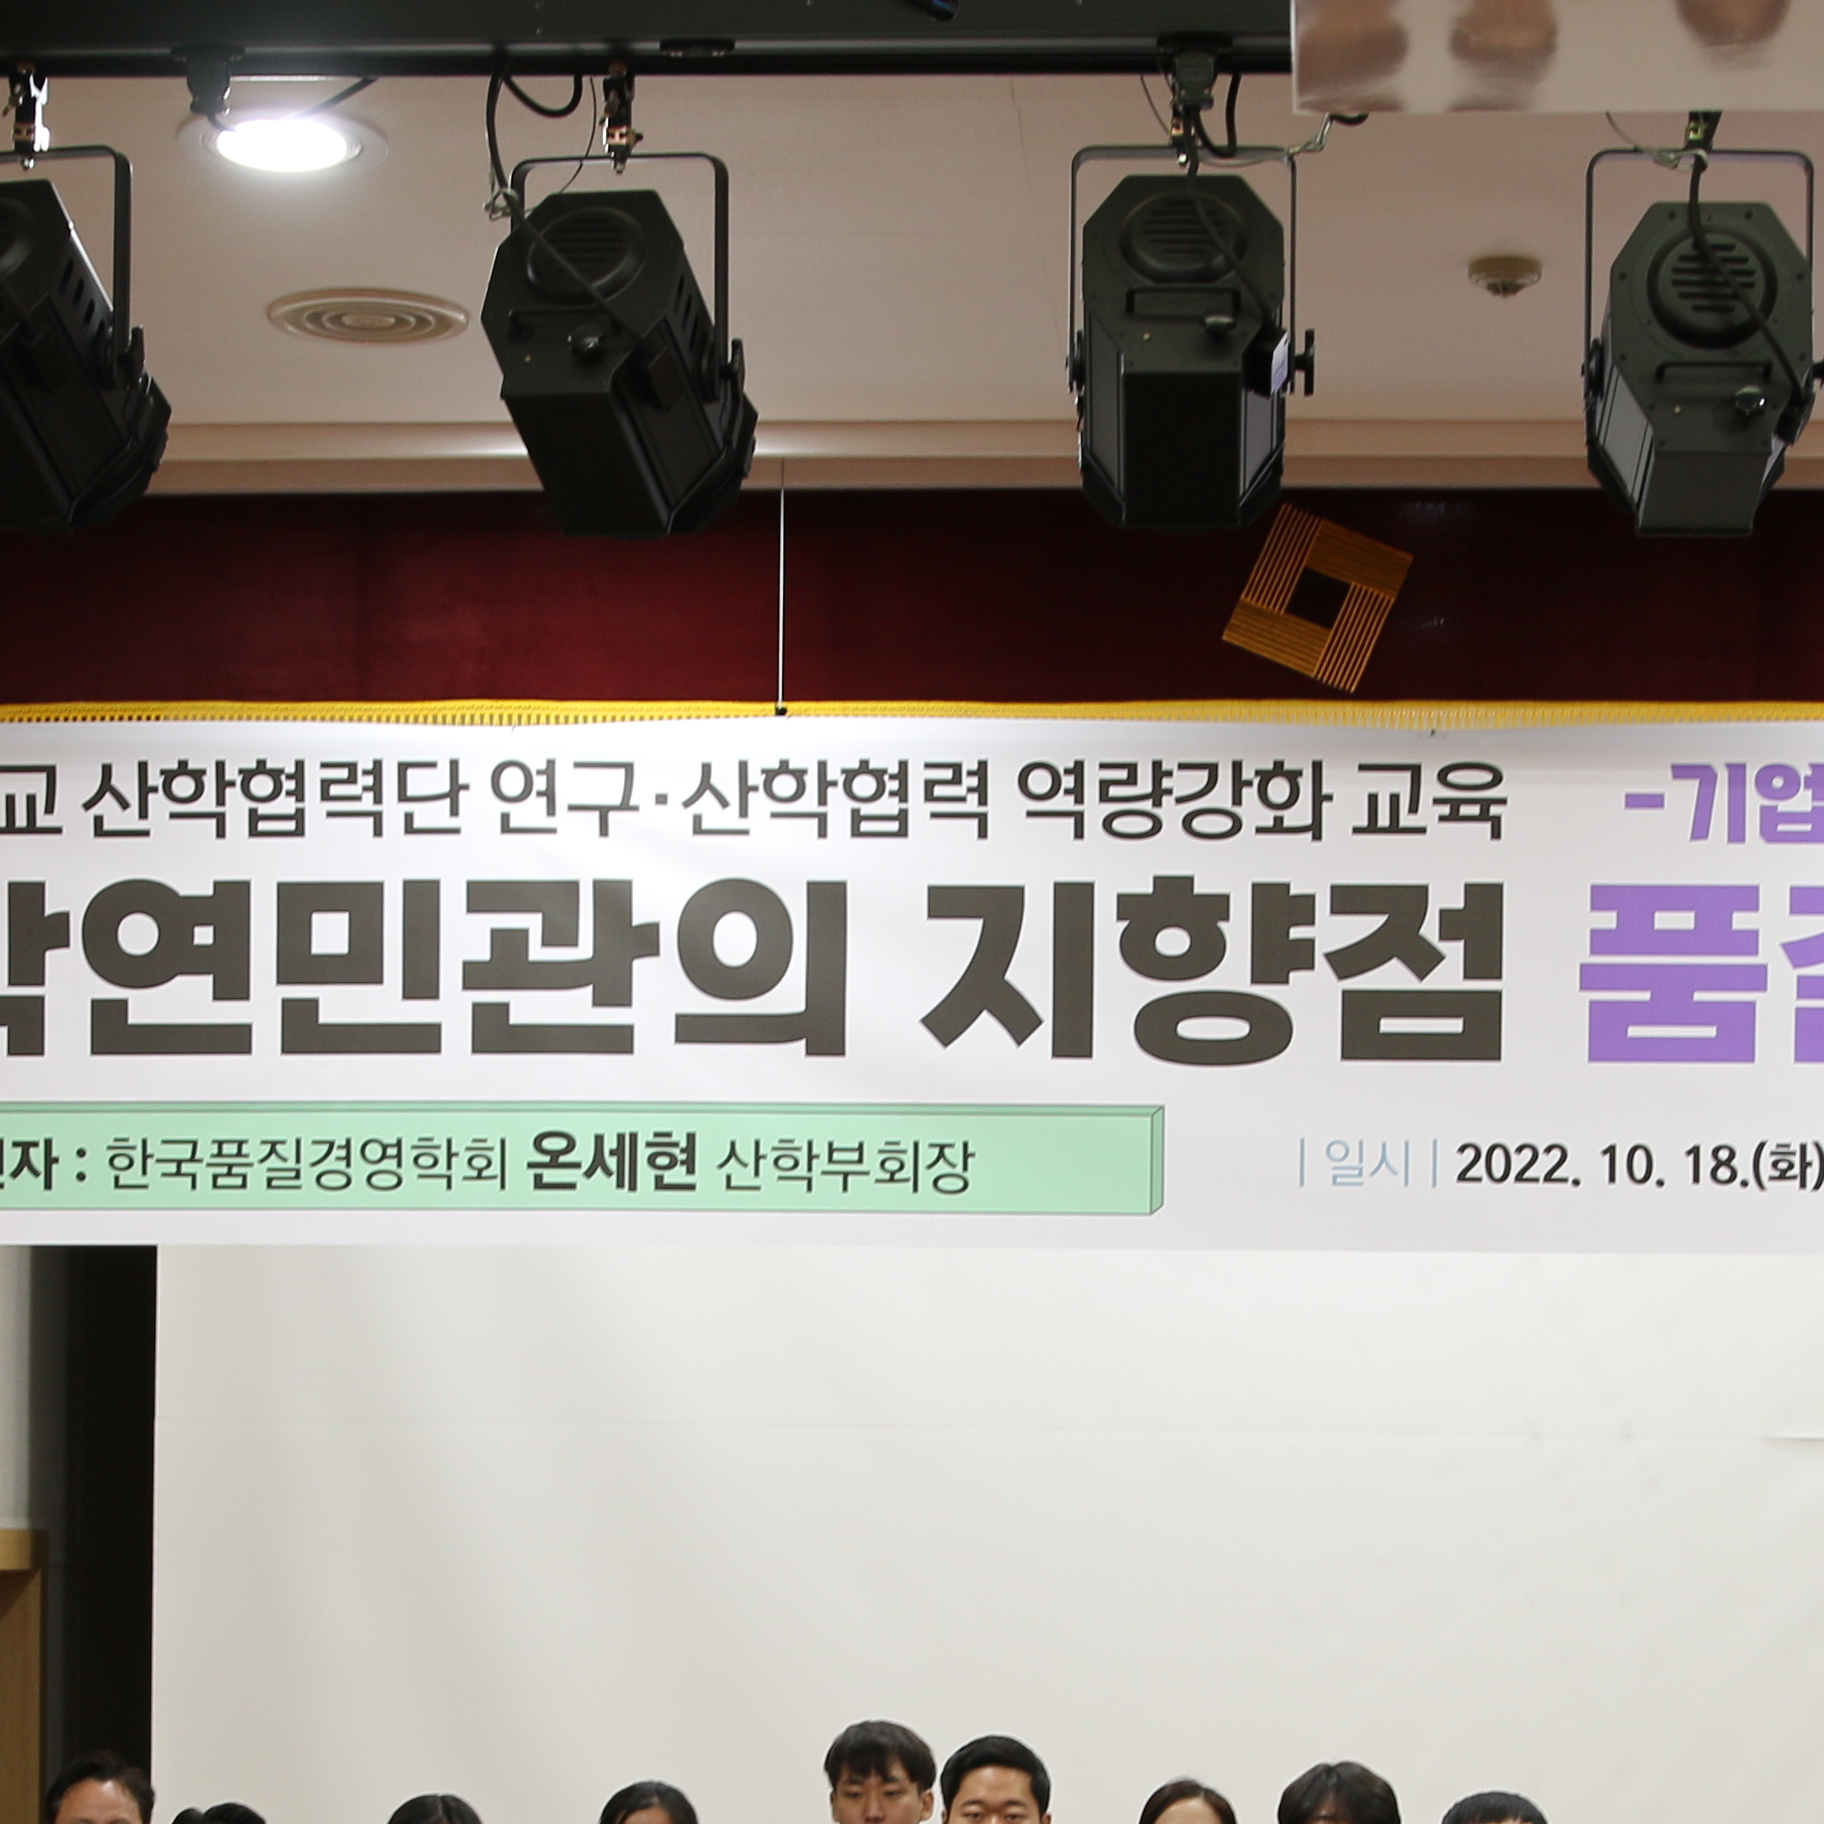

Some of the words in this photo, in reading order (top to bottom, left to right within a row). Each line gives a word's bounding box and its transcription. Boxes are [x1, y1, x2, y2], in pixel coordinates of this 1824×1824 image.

[82, 759, 468, 838] 산학협력단
[491, 760, 987, 837] 연구·산학협력
[1017, 760, 1333, 840] 역량강화
[1352, 761, 1507, 839] 교육
[919, 874, 1504, 1066] 지향점
[106, 1137, 507, 1190] 한국품질경영학회
[526, 1130, 696, 1192] 온세현
[717, 1138, 975, 1194] 산학부회장
[1324, 1137, 1411, 1188] 일시
[1456, 1142, 1581, 1188] 2022.
[1600, 1142, 1666, 1188] 10.
